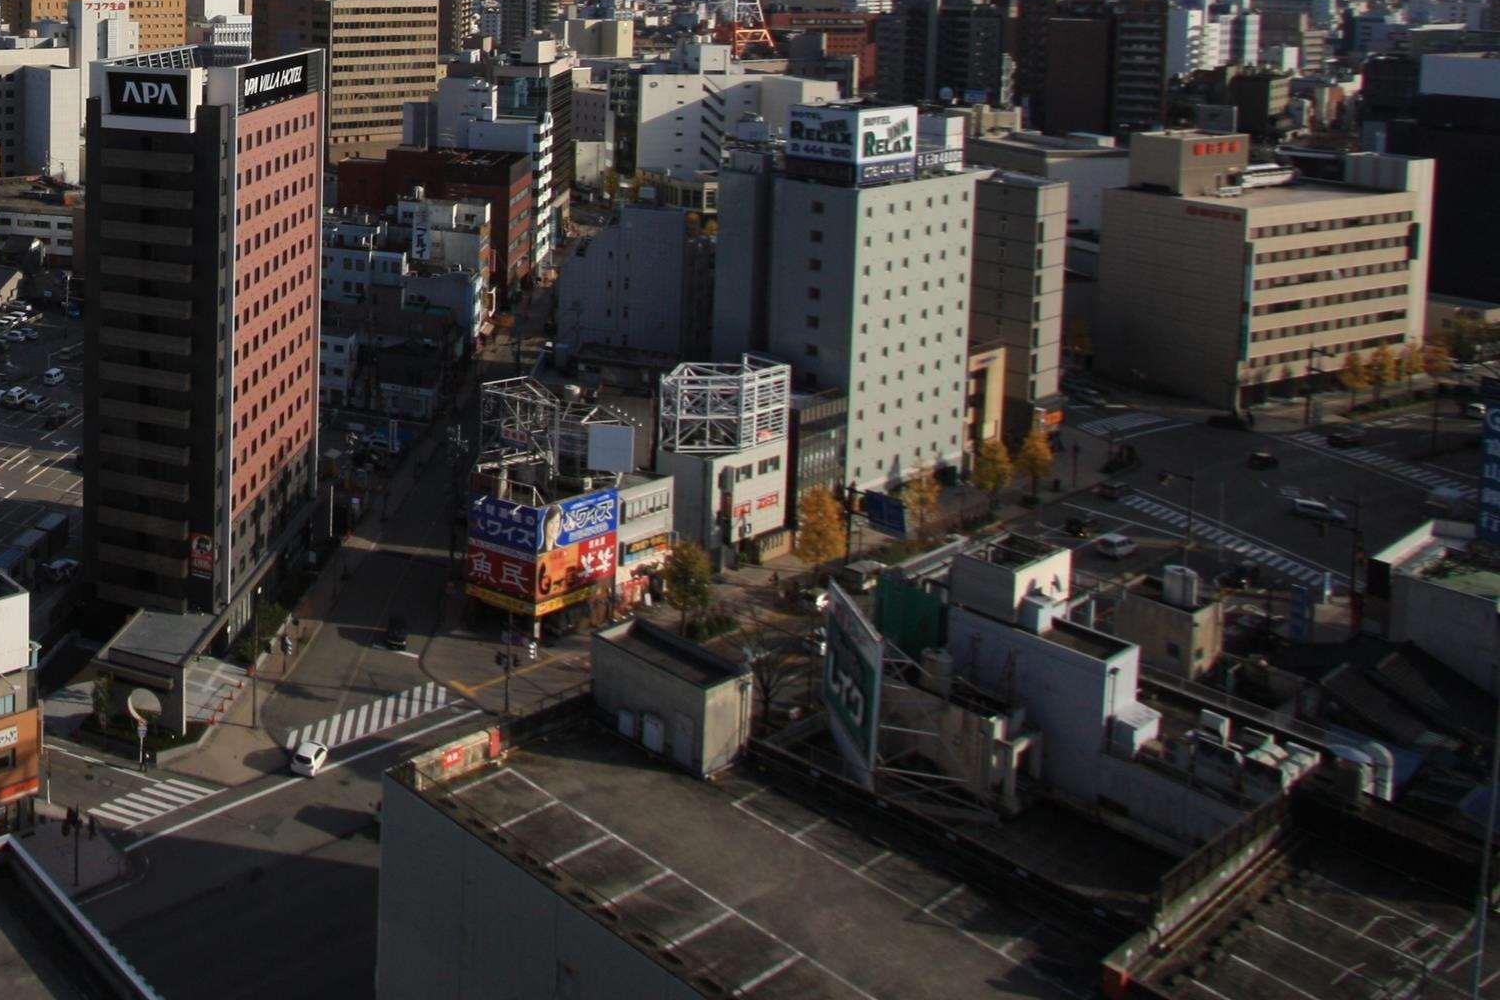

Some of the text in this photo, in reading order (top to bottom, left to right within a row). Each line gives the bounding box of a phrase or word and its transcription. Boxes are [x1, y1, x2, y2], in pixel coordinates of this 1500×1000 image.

[260, 71, 281, 93] VILLA
[281, 65, 303, 87] HOTEL
[122, 81, 179, 106] APA
[863, 130, 912, 158] RELAX
[468, 551, 530, 595] 魚民
